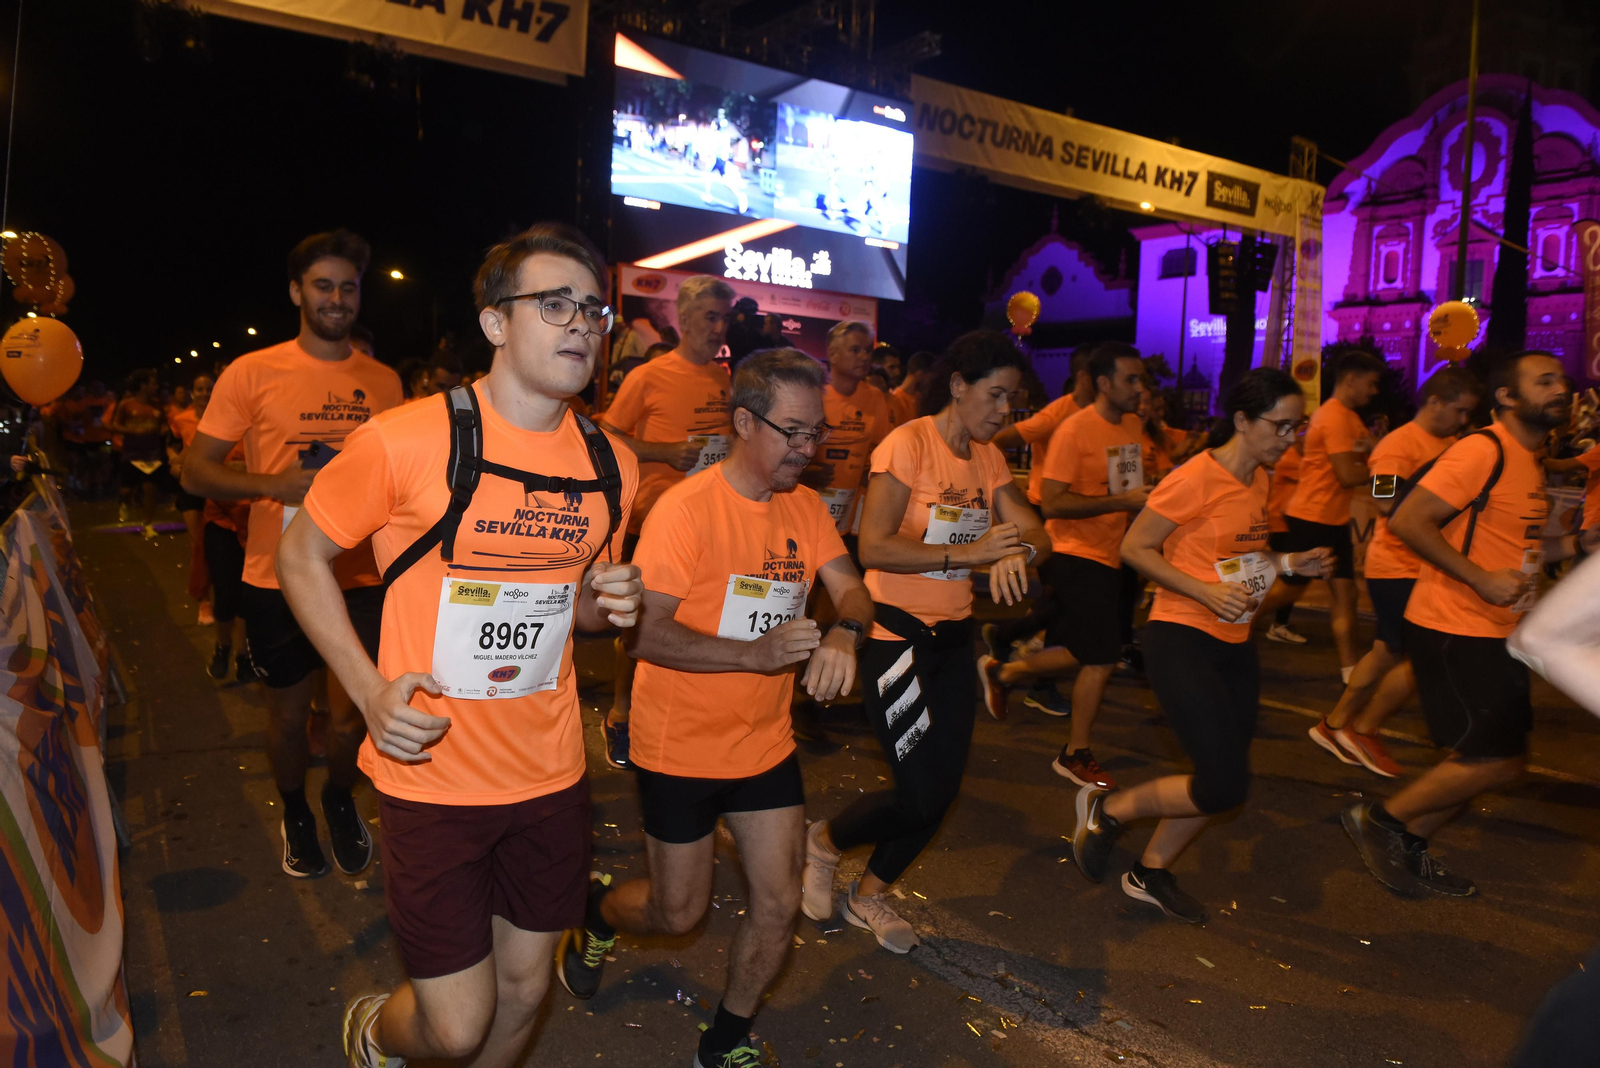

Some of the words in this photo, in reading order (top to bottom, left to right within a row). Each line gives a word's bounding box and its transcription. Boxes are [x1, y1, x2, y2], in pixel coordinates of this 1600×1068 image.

[917, 102, 1054, 161] NOCTURNA
[1060, 140, 1148, 184] SEVILLA
[299, 412, 344, 421] SEVILLA
[322, 404, 371, 413] NOCTURNA
[513, 508, 590, 528] NOCTURNA
[473, 519, 549, 539] SEVILLA
[747, 611, 797, 635] 132
[478, 622, 545, 651] 8967
